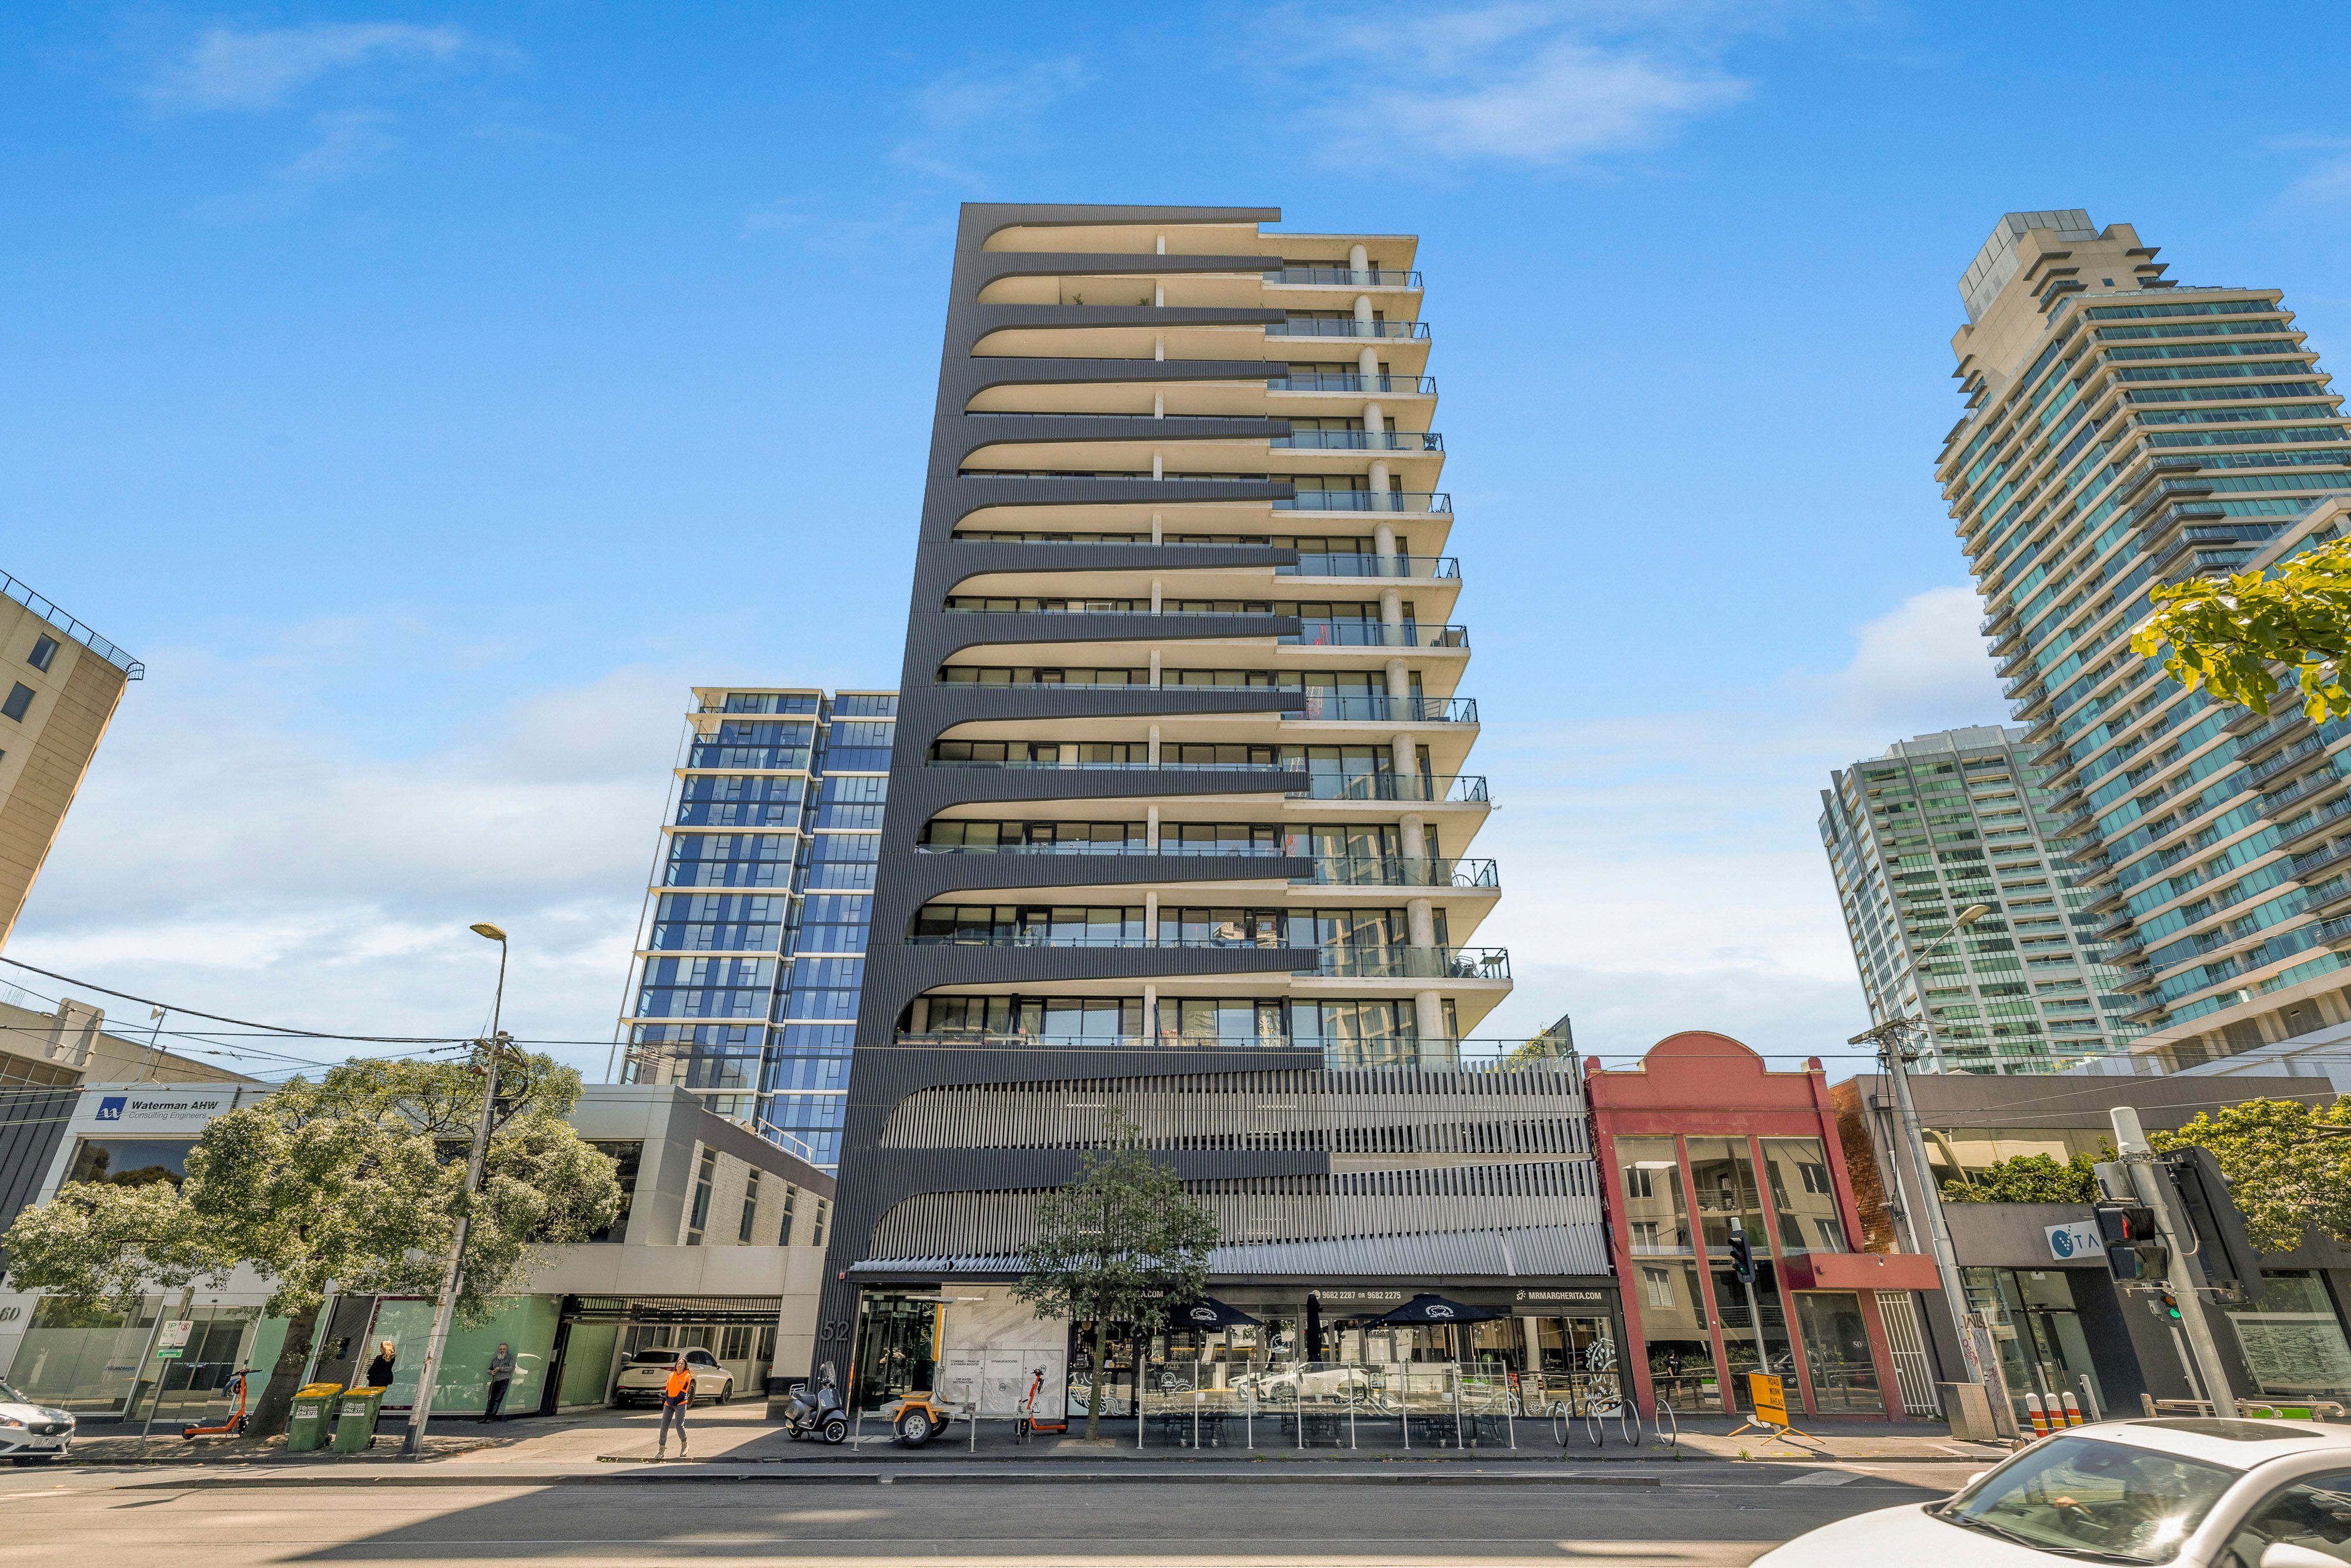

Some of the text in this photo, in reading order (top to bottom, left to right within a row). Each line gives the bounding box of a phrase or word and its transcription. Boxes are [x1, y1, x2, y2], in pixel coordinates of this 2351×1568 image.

[132, 1101, 219, 1109] Waterman AHW
[129, 1111, 206, 1120] Consulting Engineers
[0, 1307, 21, 1321] 60
[818, 1320, 850, 1341] 52
[1585, 1340, 1598, 1358] PIZZA
[1768, 1378, 1780, 1386] ROAD
[1769, 1388, 1781, 1396] WORK
[1770, 1398, 1784, 1406] AHEAD
